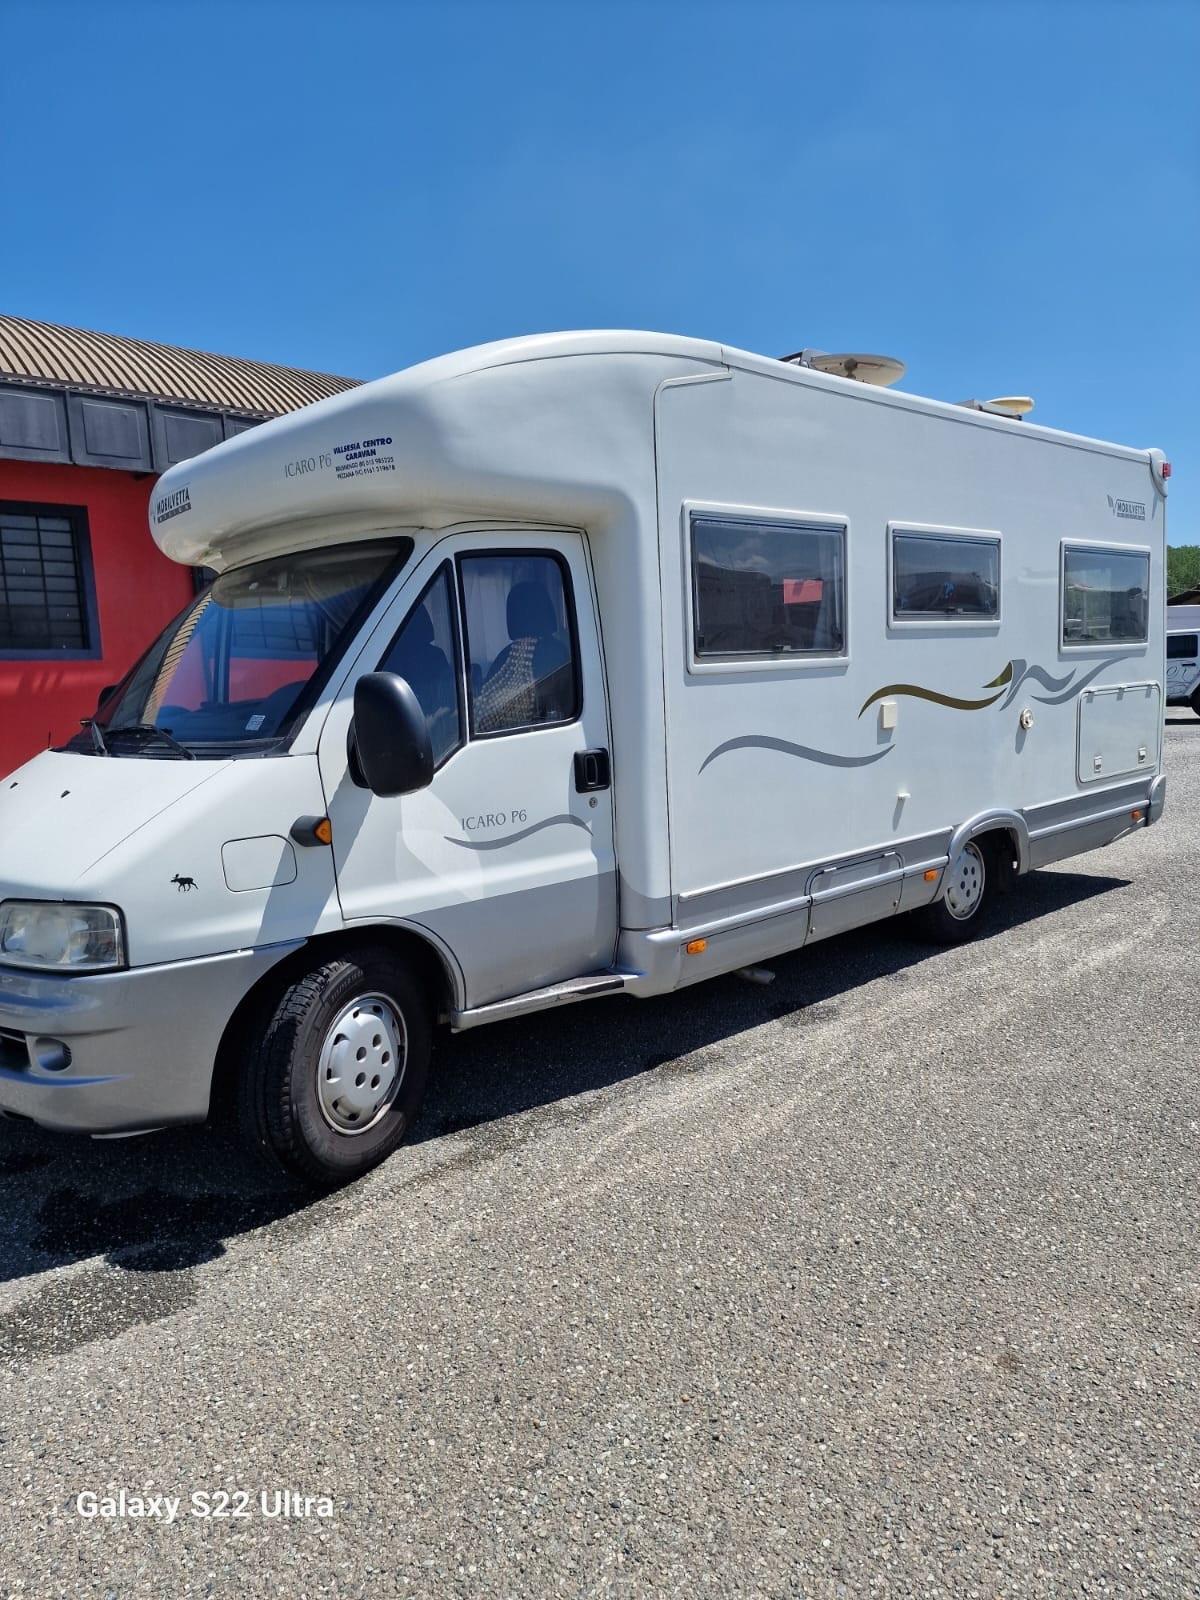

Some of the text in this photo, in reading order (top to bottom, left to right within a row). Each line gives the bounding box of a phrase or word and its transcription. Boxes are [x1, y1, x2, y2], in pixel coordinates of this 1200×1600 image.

[333, 437, 393, 455] VALSESIA CENTRO
[345, 448, 377, 461] CARAVAN
[284, 453, 332, 478] ICARO P6
[156, 487, 191, 515] MOBILVETTA
[1117, 502, 1145, 515] MOBILVETTA
[461, 809, 527, 831] ICARO P6
